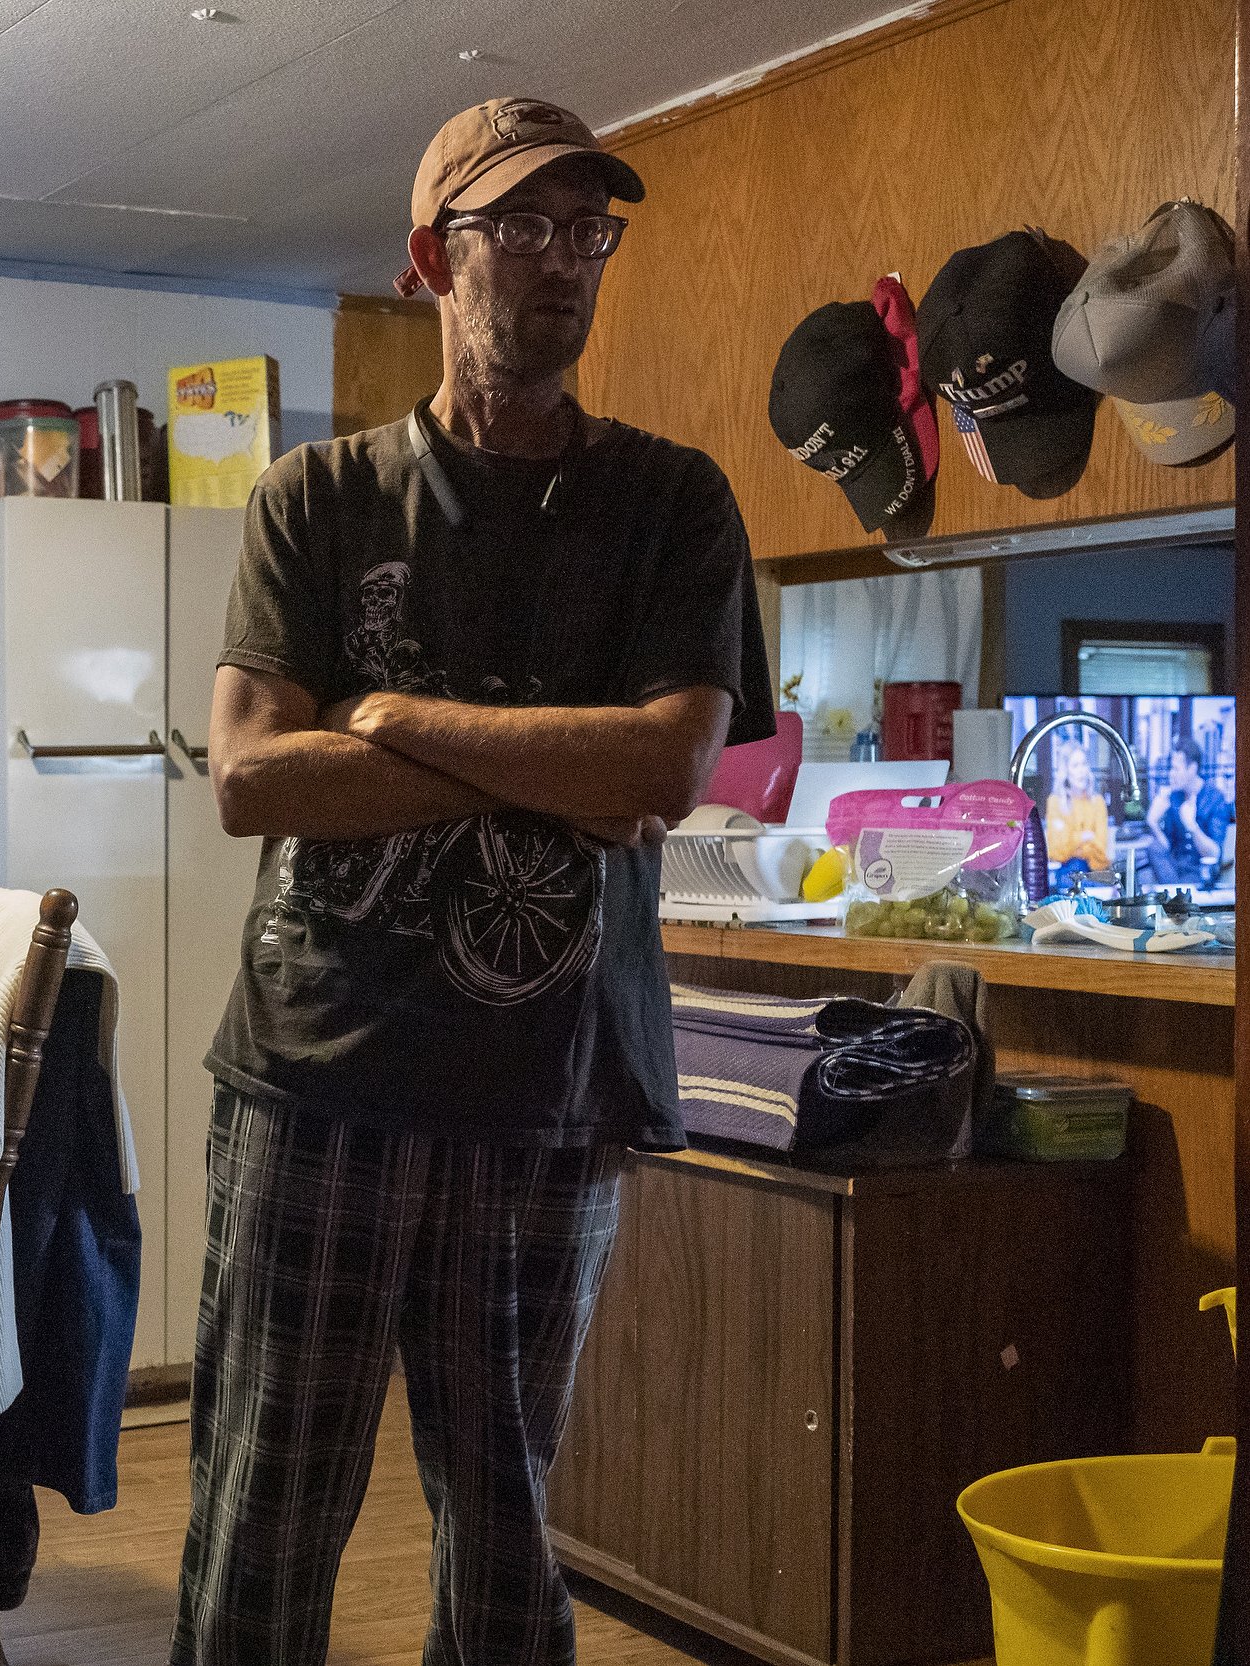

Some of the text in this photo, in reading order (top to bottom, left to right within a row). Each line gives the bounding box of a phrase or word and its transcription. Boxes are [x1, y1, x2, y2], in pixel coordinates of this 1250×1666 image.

[938, 359, 1027, 402] Trump
[798, 422, 835, 461] DON'T
[901, 442, 915, 467] DIAL
[821, 445, 868, 481] AL 911
[898, 469, 915, 500] DON'T
[884, 500, 902, 515] WE
[959, 794, 1015, 806] Cotton Candy
